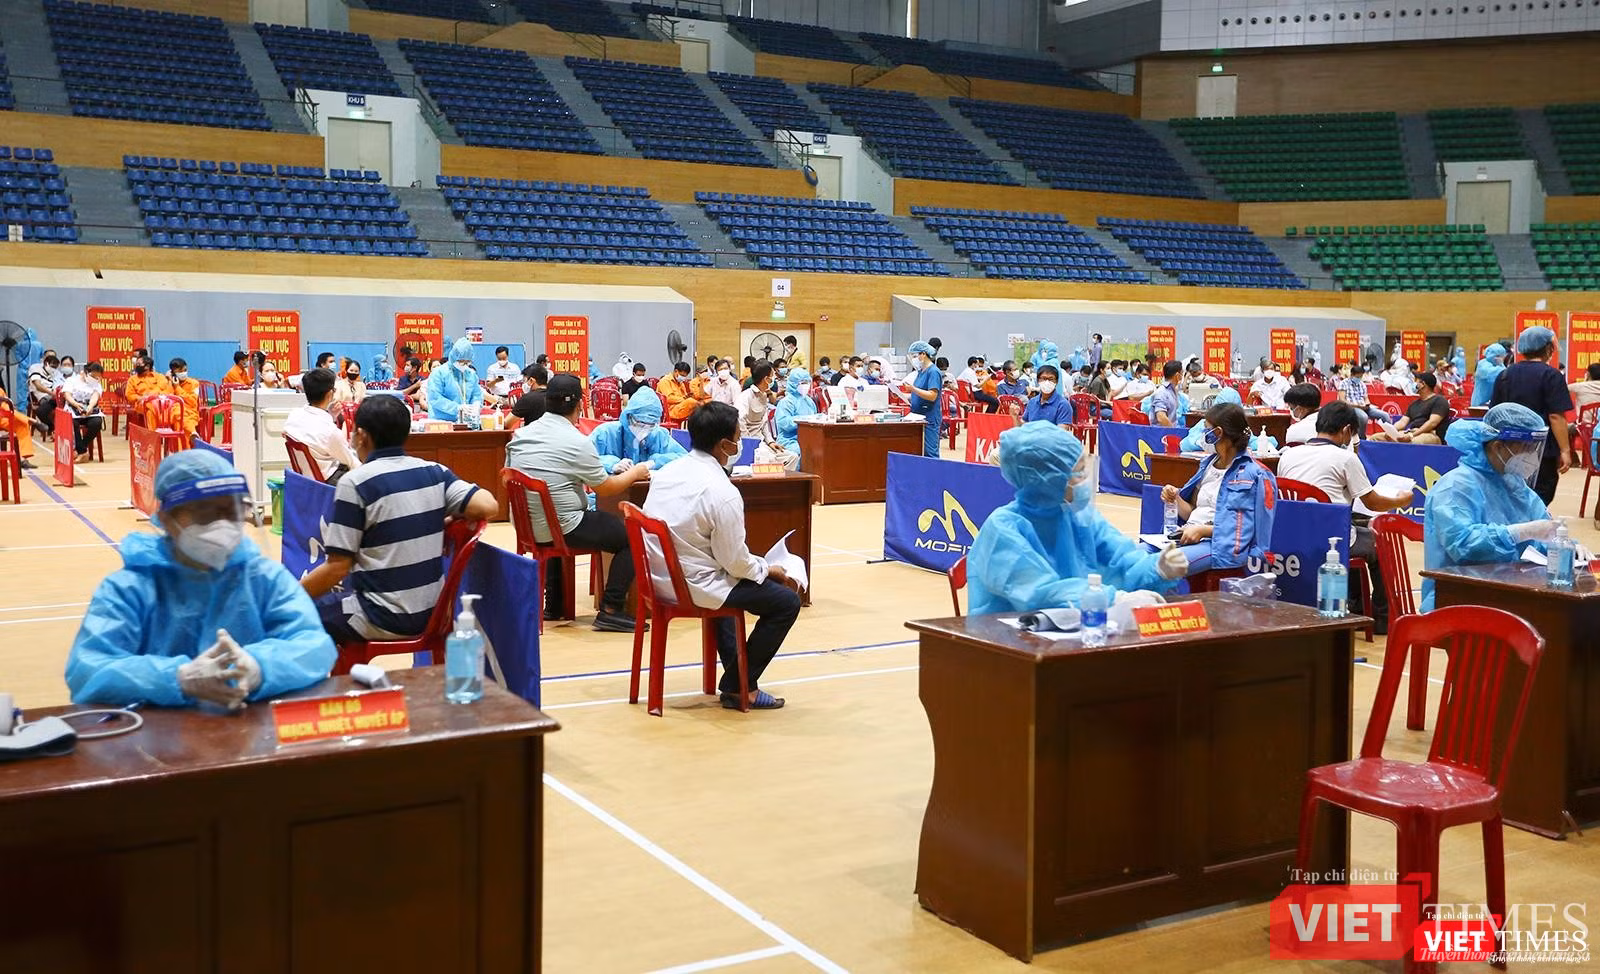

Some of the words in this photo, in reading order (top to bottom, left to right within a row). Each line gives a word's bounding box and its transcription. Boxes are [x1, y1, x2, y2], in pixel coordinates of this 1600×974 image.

[114, 312, 124, 320] TÂM
[130, 312, 135, 320] TẾ
[91, 322, 104, 331] QUẬN
[106, 322, 115, 330] NGŨ
[117, 322, 130, 330] HÀNH
[100, 338, 116, 352] KHU
[118, 336, 133, 354] VỰC
[976, 438, 1000, 462] KA
